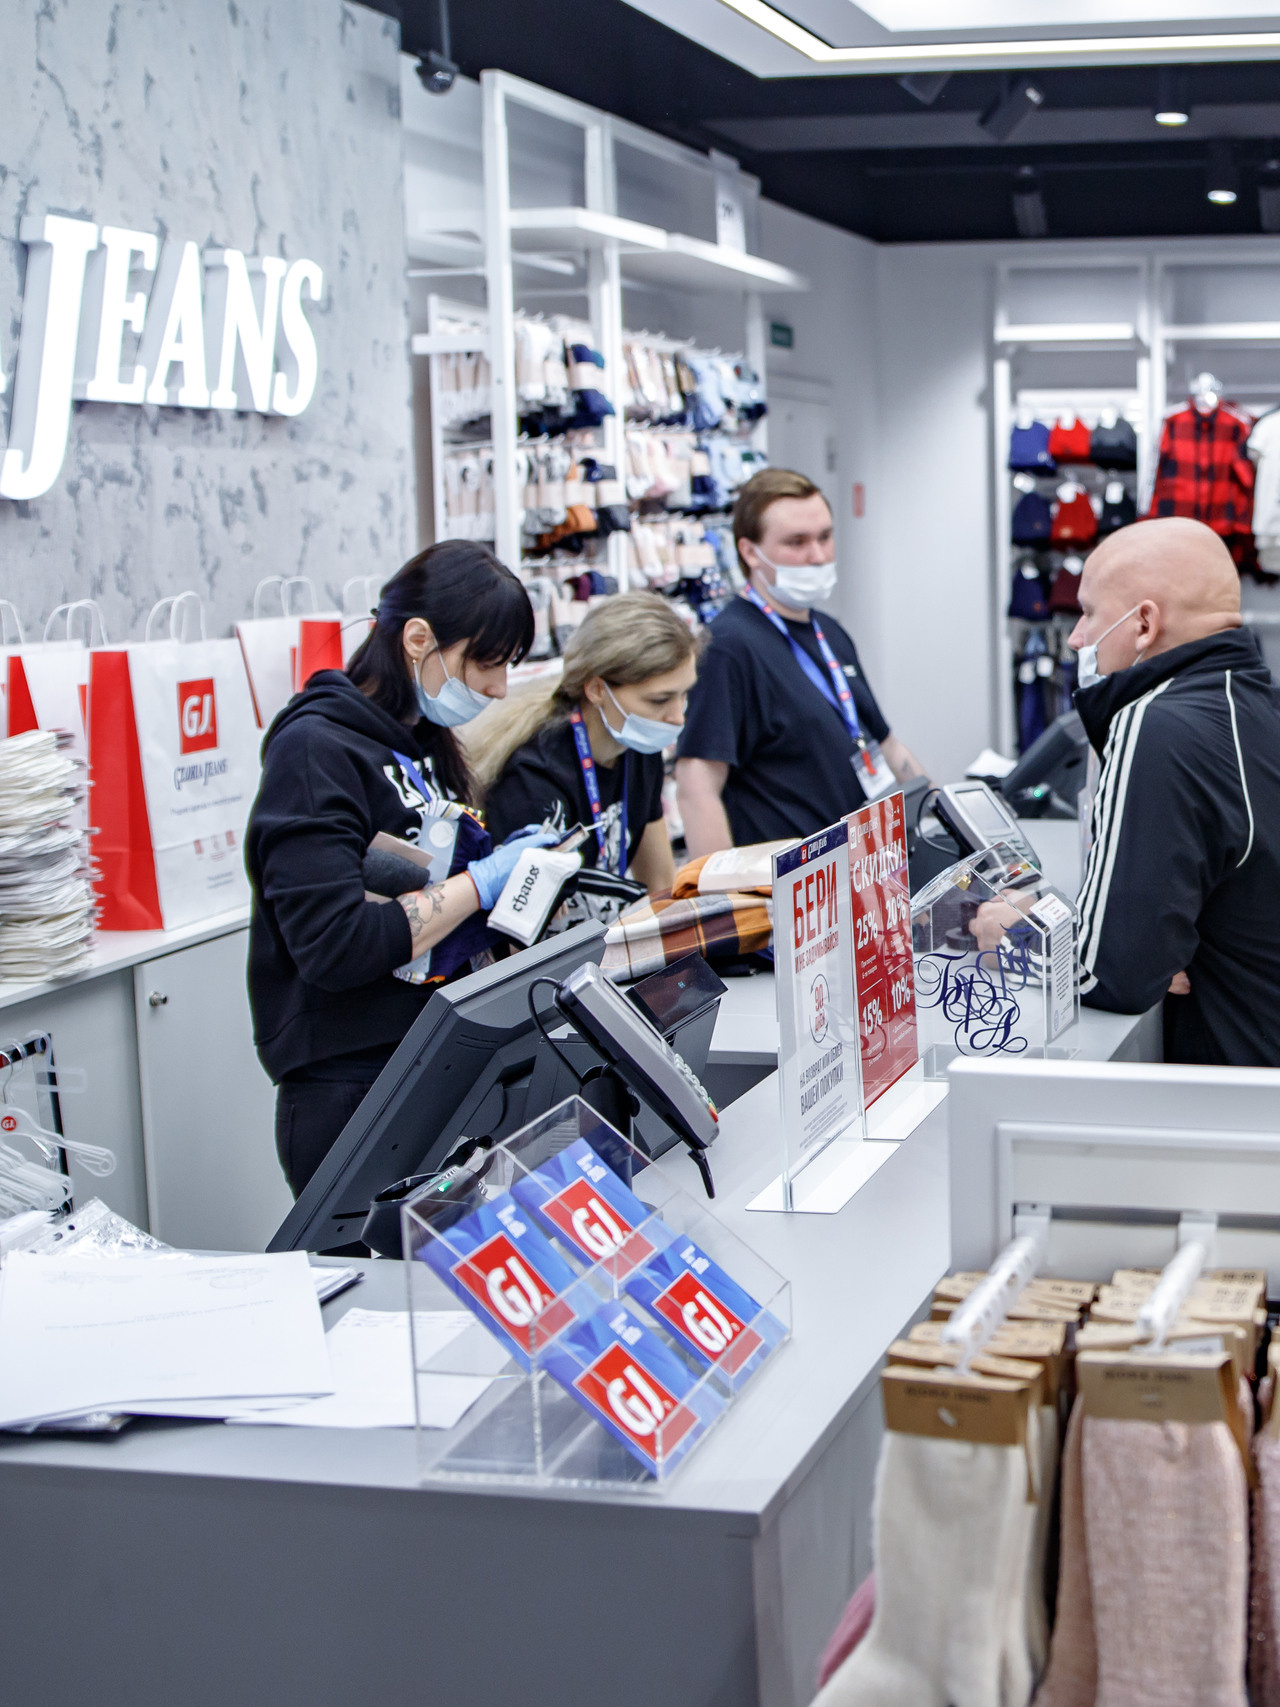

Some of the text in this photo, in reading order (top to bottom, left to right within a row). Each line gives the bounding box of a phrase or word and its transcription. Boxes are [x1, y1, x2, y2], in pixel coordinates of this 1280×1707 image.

[0, 213, 324, 501] JEANS
[852, 838, 903, 893] СКИДКИ
[793, 861, 838, 950] БЕРИ
[856, 909, 878, 951] 25%
[885, 892, 907, 931] 20%
[815, 983, 824, 1012] 90
[862, 996, 883, 1037] 15%
[891, 974, 911, 1014] 10%
[801, 1061, 844, 1116] ВАШЕЙ ПОКУПКИ
[571, 1197, 627, 1259] GJ
[486, 1255, 543, 1328] GJ
[681, 1290, 734, 1353] GJ
[606, 1364, 666, 1437] GJ
